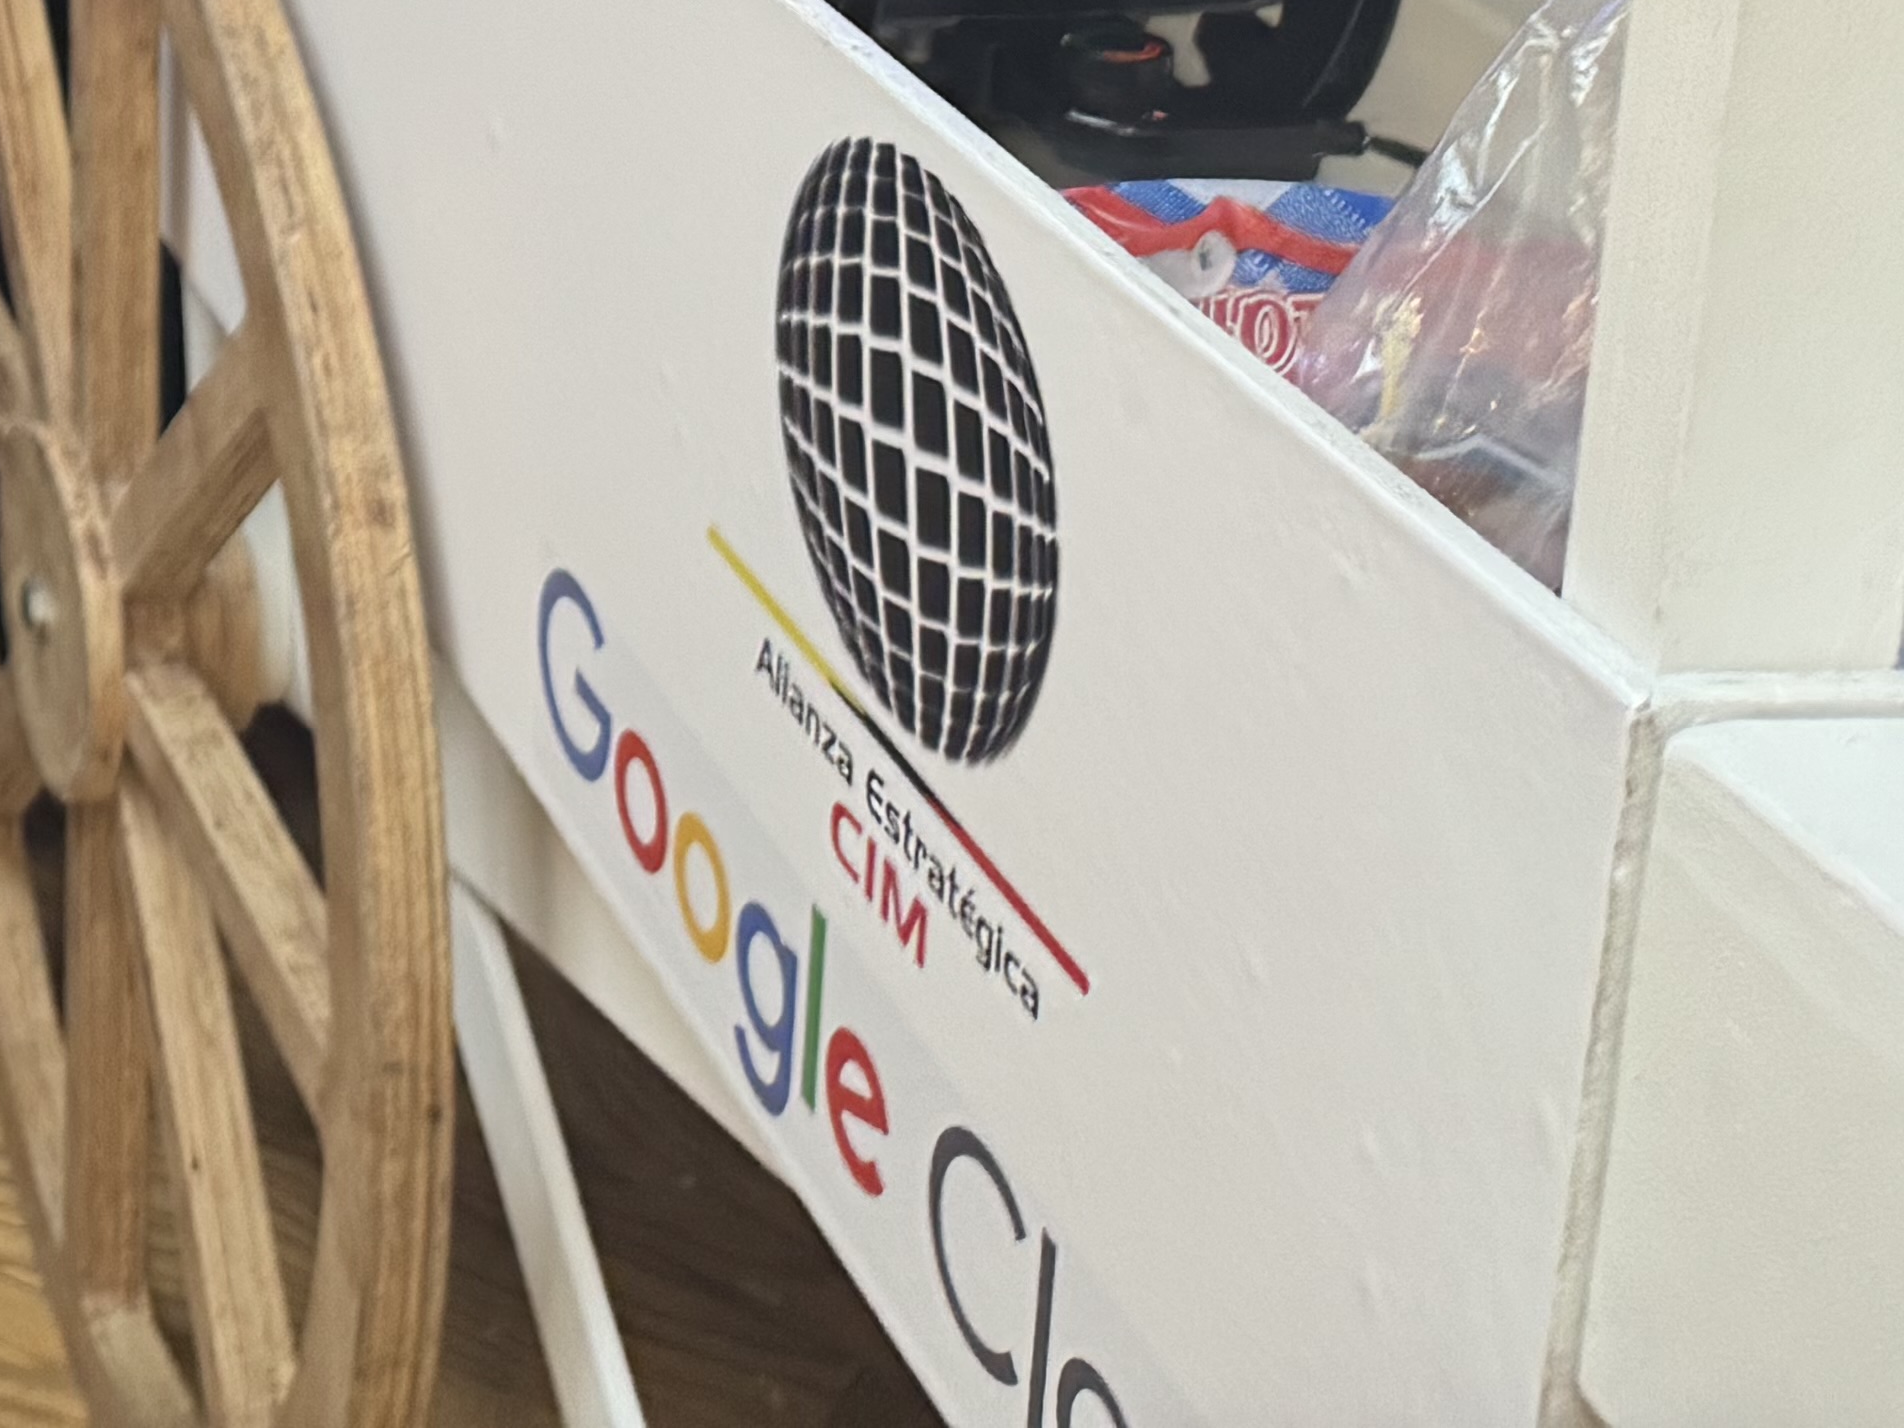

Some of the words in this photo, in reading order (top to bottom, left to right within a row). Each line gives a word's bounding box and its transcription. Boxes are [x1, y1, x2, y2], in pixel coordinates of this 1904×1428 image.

[537, 568, 890, 1198] Google
[755, 637, 854, 786] Alianza
[865, 768, 1039, 1021] Estratégica
[830, 800, 930, 969] CIM
